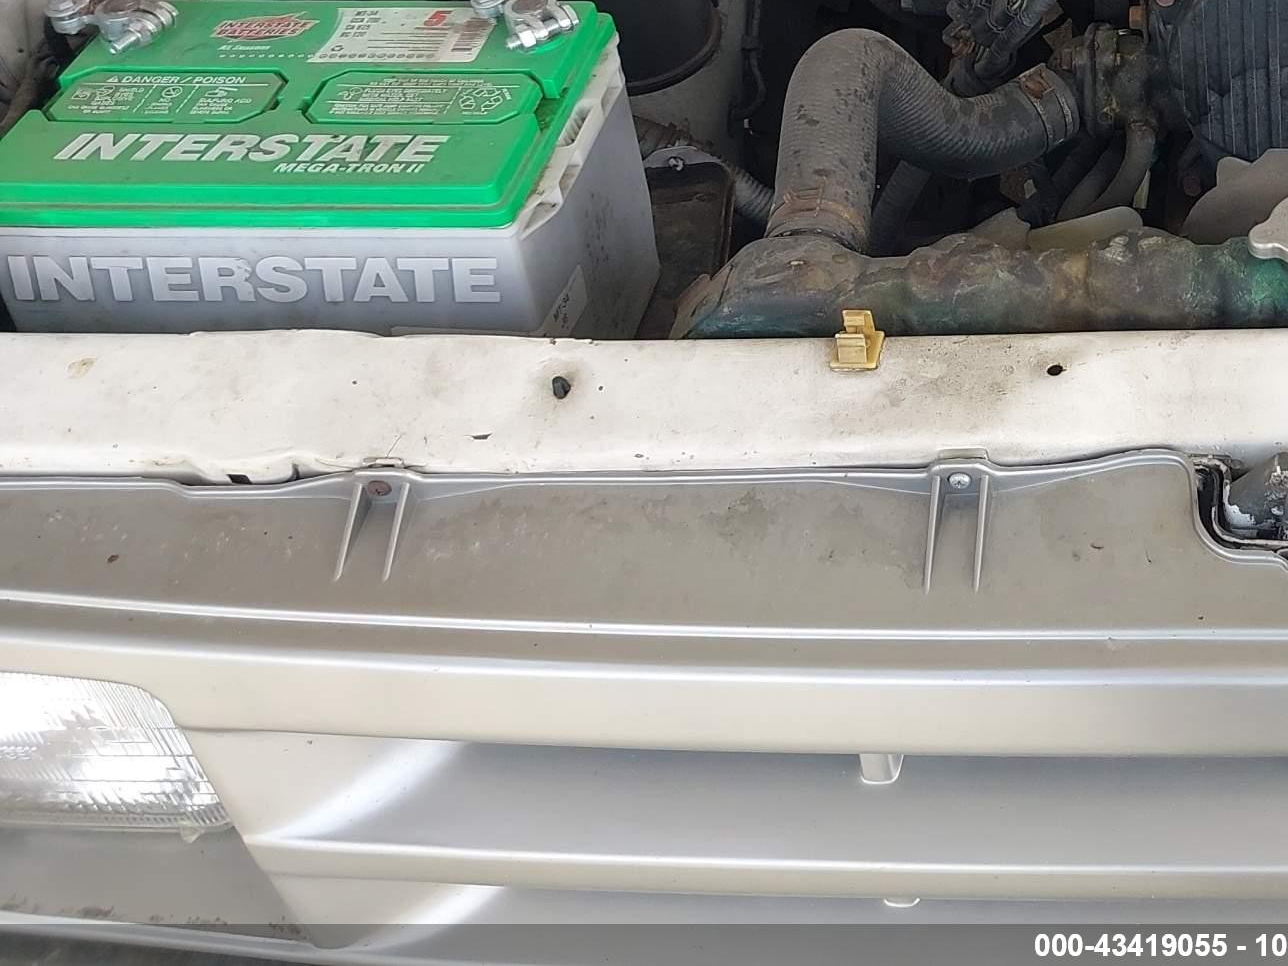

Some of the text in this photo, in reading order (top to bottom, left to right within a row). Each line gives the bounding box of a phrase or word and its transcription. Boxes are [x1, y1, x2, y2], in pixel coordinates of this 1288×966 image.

[220, 20, 309, 30] INTERSTATE
[423, 10, 453, 27] 5
[121, 76, 183, 84] DANGER
[193, 76, 247, 84] POISON
[53, 133, 452, 163] INTERSTATE
[273, 162, 404, 174] MEGA-TRON
[6, 255, 501, 304] INTERSTATE
